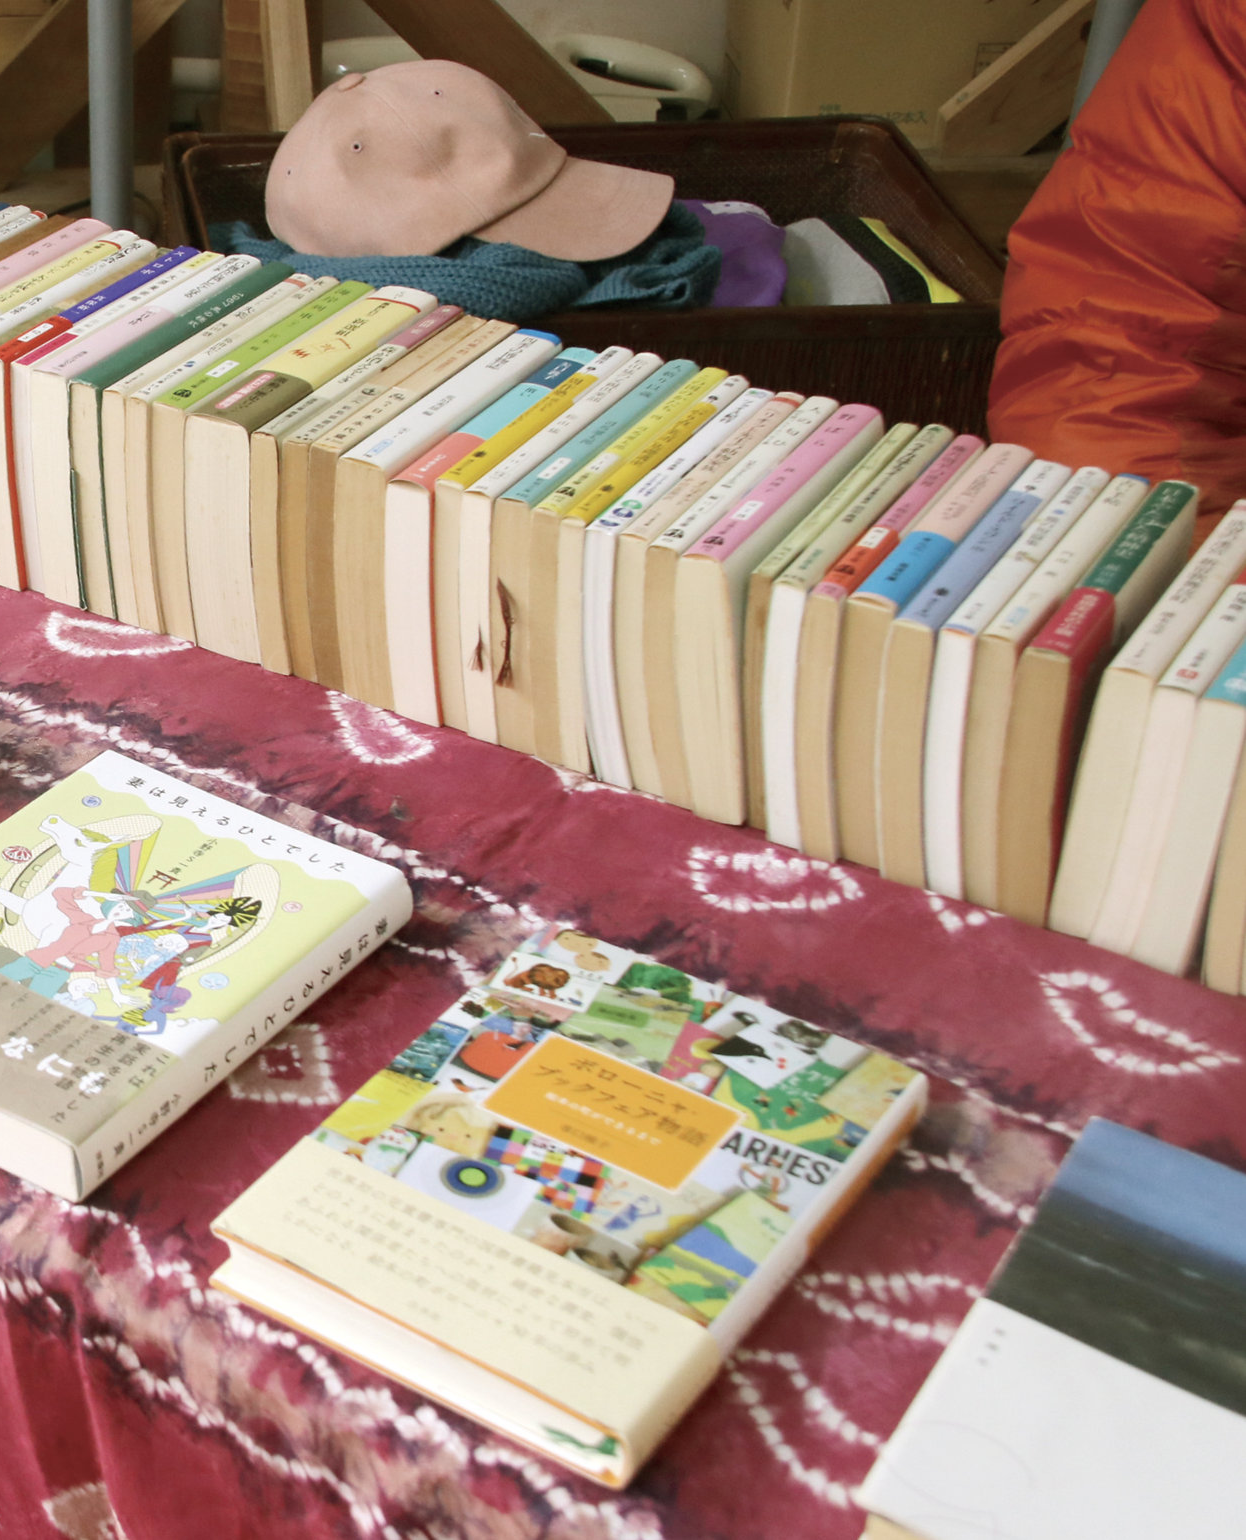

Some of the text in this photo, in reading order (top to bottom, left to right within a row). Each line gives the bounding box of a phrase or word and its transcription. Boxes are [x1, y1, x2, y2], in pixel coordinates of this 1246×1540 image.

[121, 773, 351, 876] 妻は見えるひとでした
[165, 836, 223, 876] 小野寺S一貴
[200, 914, 391, 1085] 妻は見えるひとでした
